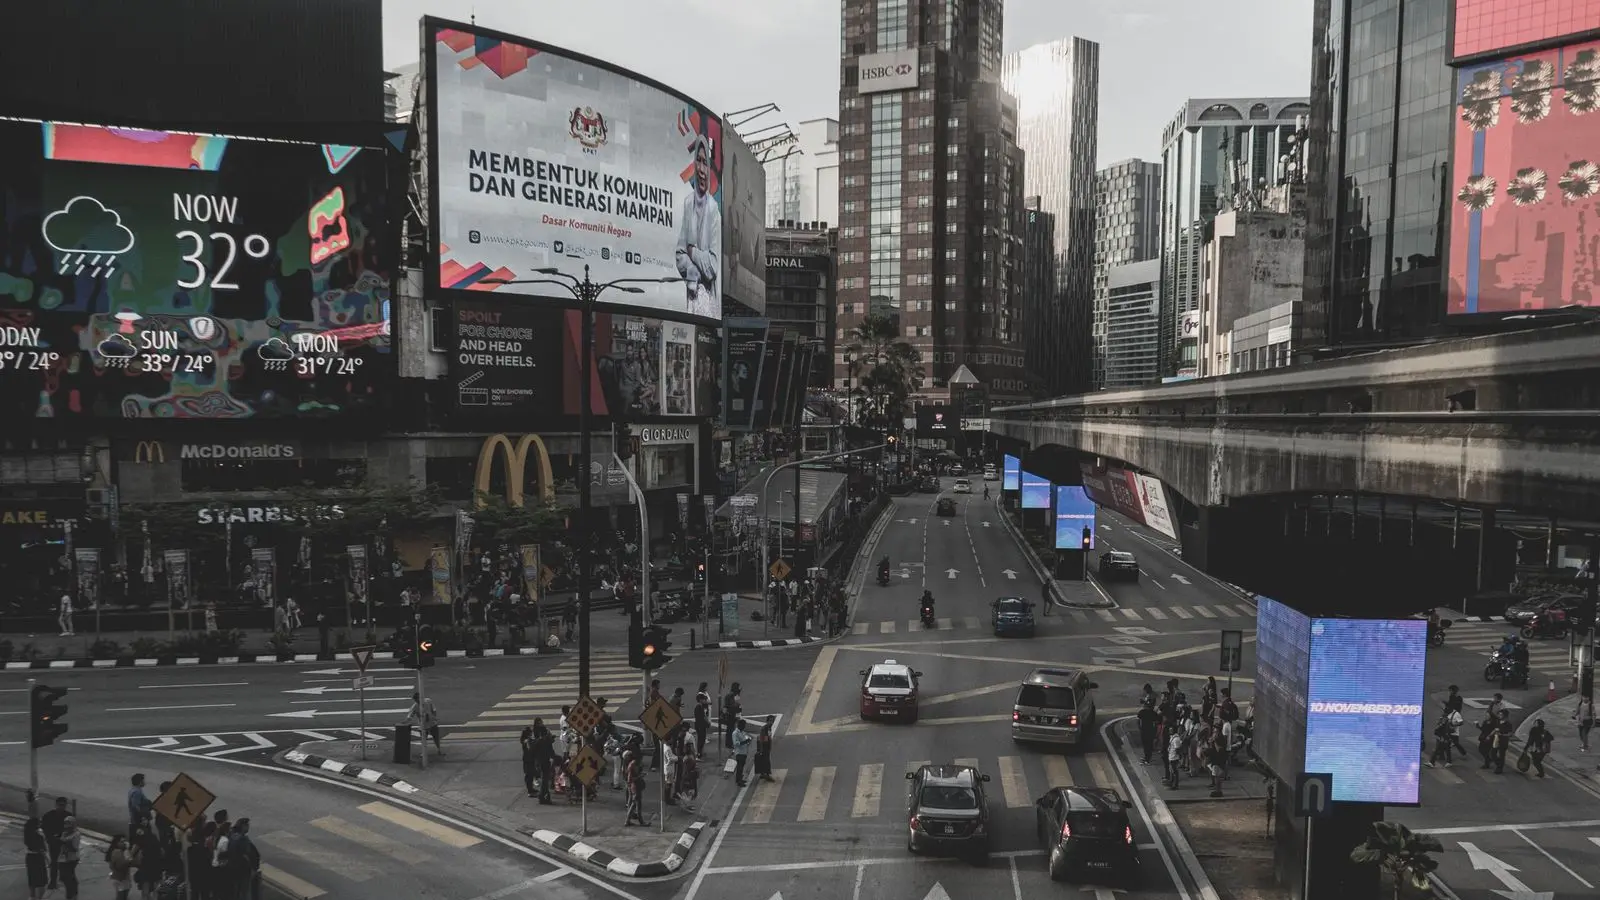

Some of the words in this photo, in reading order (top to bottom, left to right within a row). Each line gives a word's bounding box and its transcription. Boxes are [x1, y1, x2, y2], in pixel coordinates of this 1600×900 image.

[862, 66, 894, 80] HSBC
[469, 149, 599, 191] MEMBENTUK
[603, 173, 673, 209] KOMUNITI
[469, 172, 515, 198] DAN
[522, 181, 612, 214] GENERASI
[616, 197, 673, 228] MAMPAN
[173, 193, 239, 223] NOW
[541, 214, 567, 228] Dasar
[569, 218, 606, 233] Komuniti
[607, 224, 632, 238] Negara
[176, 230, 270, 290] 32°
[765, 257, 804, 268] URNAL
[459, 310, 502, 324] SPOILT
[459, 324, 486, 337] FOR
[487, 326, 533, 340] CHOICE
[140, 330, 178, 350] SUN
[298, 334, 338, 353] MON
[459, 339, 487, 351] AND
[489, 341, 522, 352] HEAD
[459, 353, 493, 366] OVER
[495, 355, 536, 368] HEELS.
[506, 388, 533, 396] SHOWING
[641, 427, 690, 442] GIORDANO
[180, 444, 294, 458] McDonald's
[2, 511, 48, 524] AKE
[197, 504, 345, 524] STARBKS
[1309, 702, 1324, 713] 10
[1323, 702, 1391, 714] NOVEMBER
[1391, 704, 1421, 715] 2019
